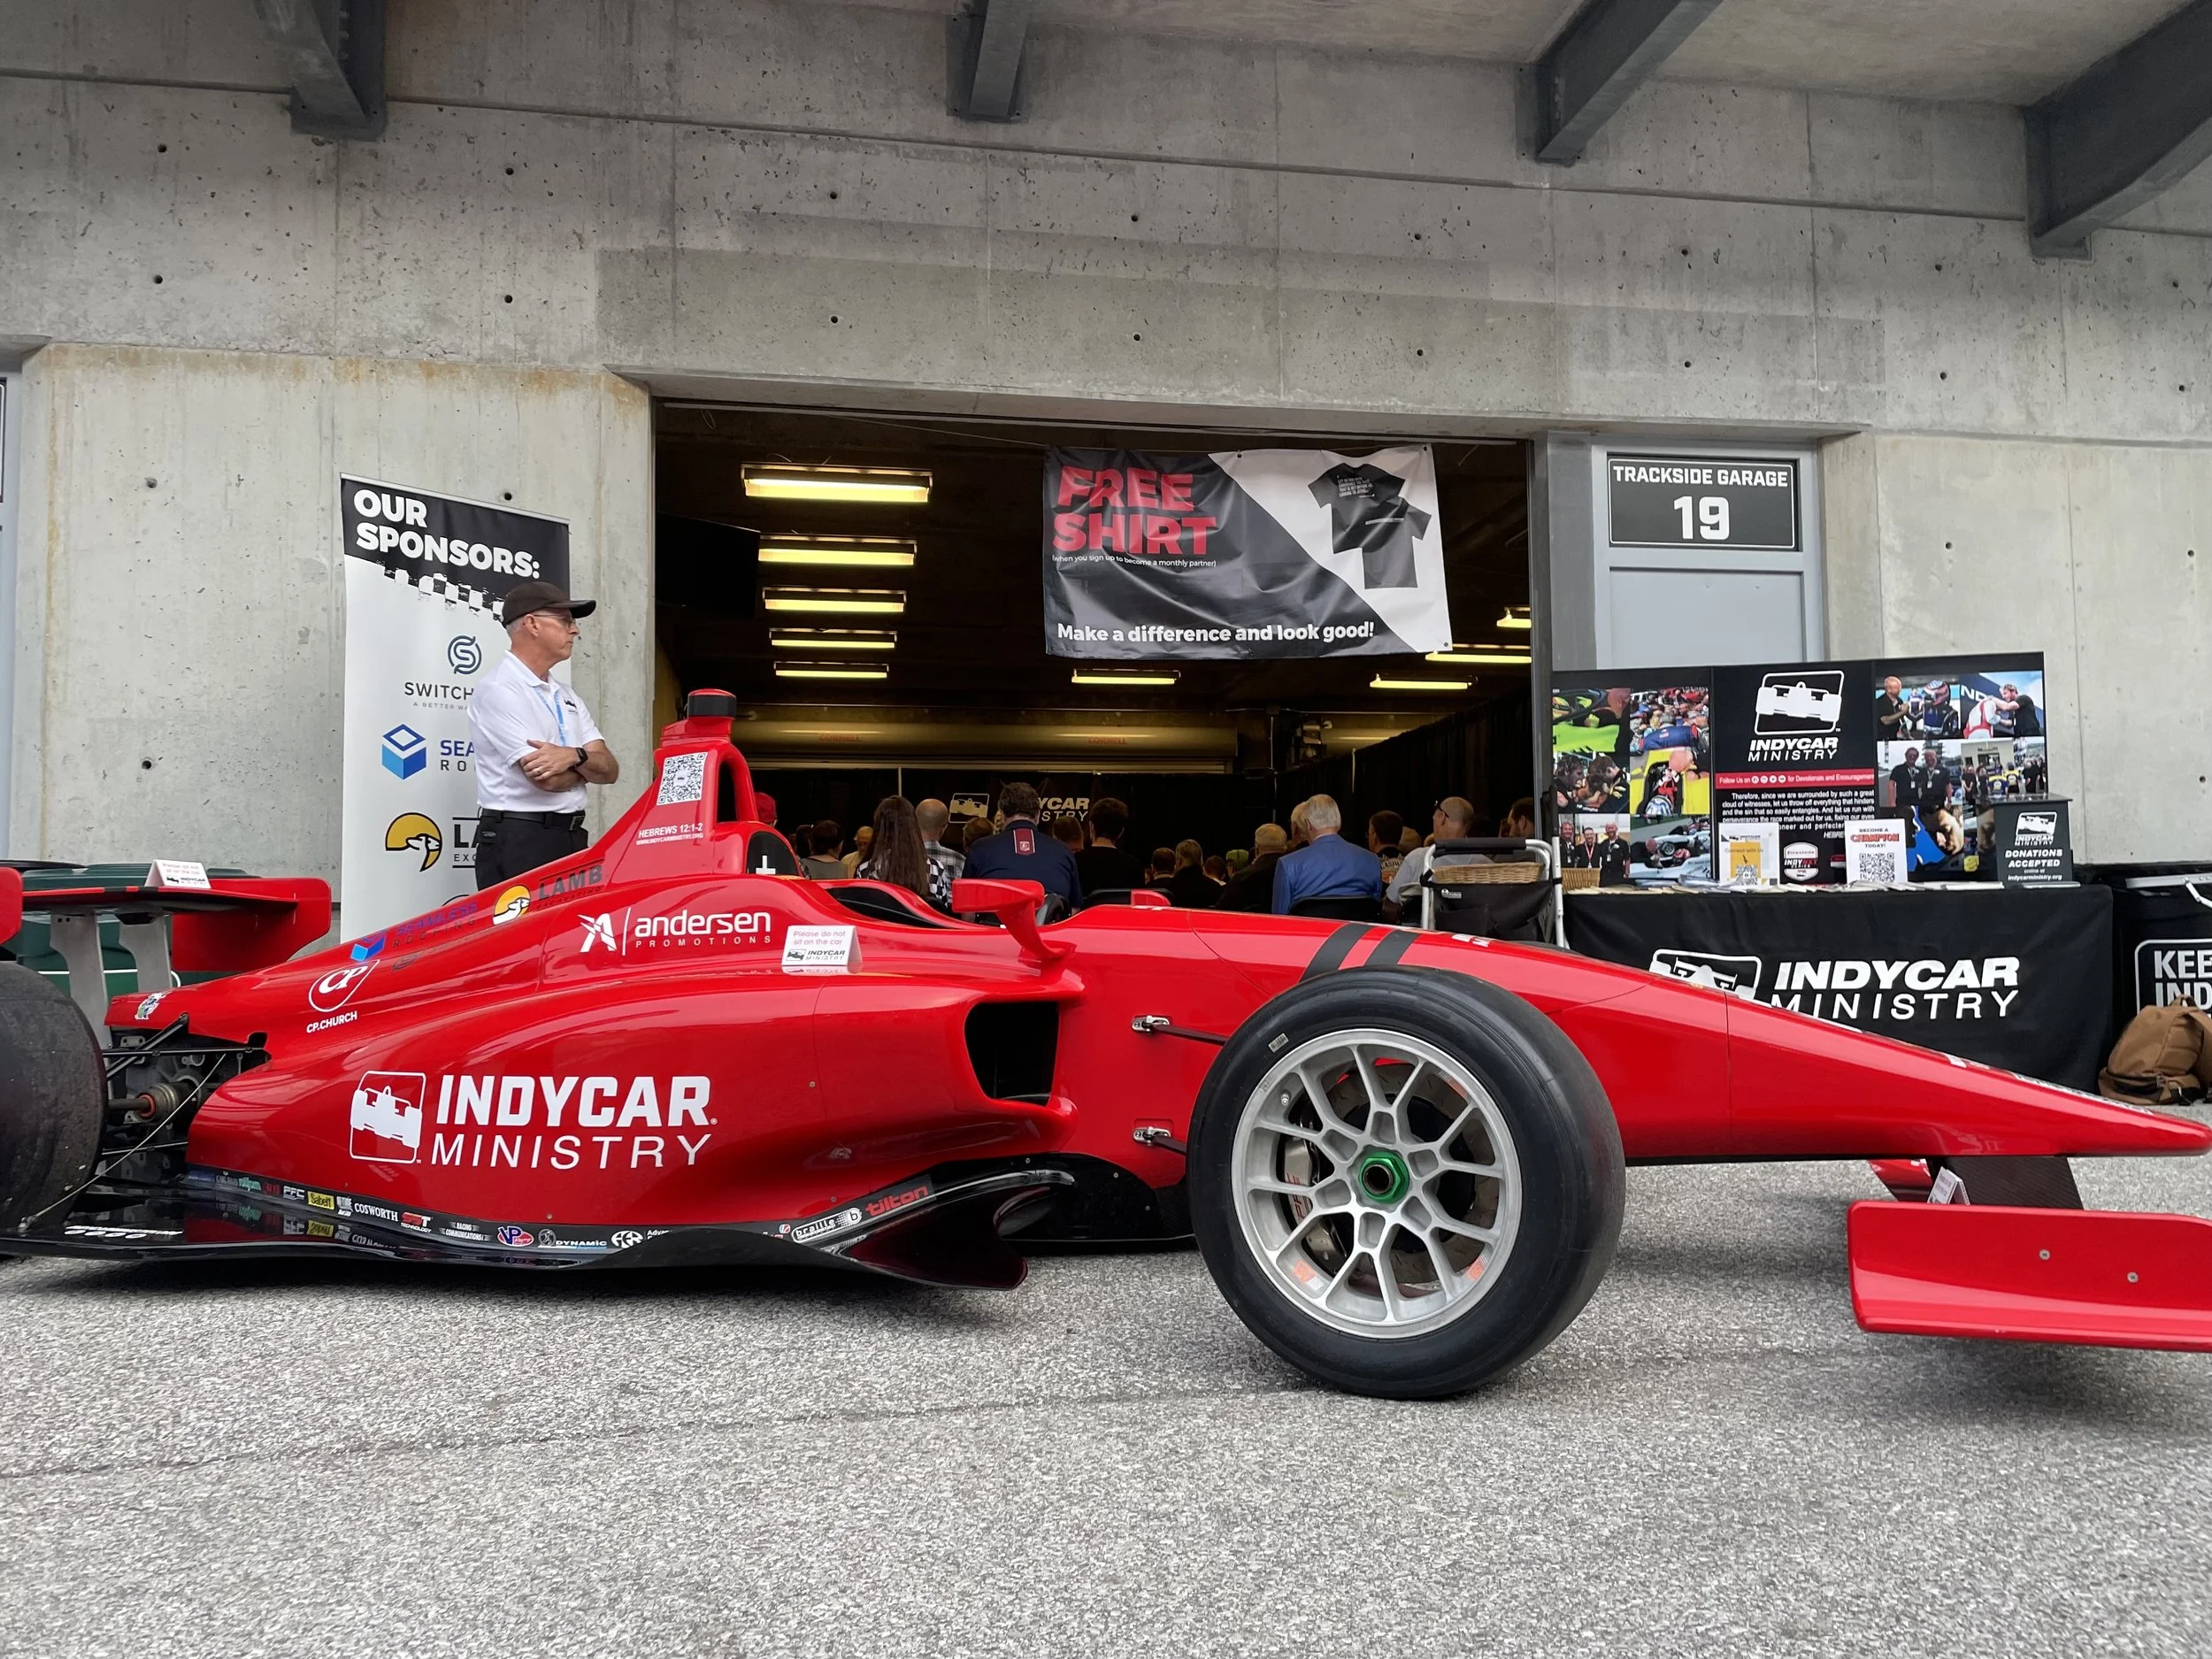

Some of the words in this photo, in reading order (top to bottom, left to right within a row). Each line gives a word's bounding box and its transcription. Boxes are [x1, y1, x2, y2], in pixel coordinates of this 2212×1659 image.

[1613, 465, 1713, 485] TRACKSIDE
[1717, 469, 1788, 487] GARAGE
[1057, 465, 1194, 511] FREE
[354, 488, 428, 529] OUR
[1674, 495, 1730, 540] 19
[1052, 511, 1217, 556] SHIRT
[356, 522, 541, 580] SPONSORS:
[1074, 555, 1087, 564] you
[1089, 554, 1104, 563] sign
[1125, 557, 1152, 566] become
[1158, 558, 1188, 568] monthly
[1057, 623, 1109, 641] Make
[1112, 630, 1125, 641] a
[1127, 624, 1232, 642] difference
[1234, 624, 1273, 641] and
[1277, 623, 1320, 641] look
[1323, 620, 1374, 643] good!
[1749, 736, 1839, 751] INDYCAR
[1747, 749, 1838, 762] MINISTRY
[1788, 798, 1804, 807] throw
[1813, 798, 1842, 807] everything
[1842, 797, 1853, 806] that
[1854, 796, 1875, 805] hinders
[1797, 790, 1830, 799] surrounded
[1830, 790, 1839, 799] by
[1859, 789, 1875, 798] great
[1774, 806, 1791, 816] easily
[1792, 806, 1820, 816] entangles.
[1862, 804, 1875, 813] with
[1783, 814, 1804, 823] marked
[1834, 812, 1849, 822] fixing
[638, 825, 678, 839] HEBREWS
[680, 822, 703, 833] 12:1-2
[1850, 833, 1900, 842] CHAMPION
[2005, 849, 2063, 858] DONATIONS
[2008, 859, 2061, 868] ACCEPTED
[538, 864, 603, 902] LAMB
[396, 902, 478, 935] SEAMLESS
[634, 910, 772, 938] andersen
[635, 935, 772, 949] PROMOTIONS
[1774, 956, 2020, 991] INDYCAR
[1770, 989, 2019, 1021] MINISTRY
[306, 1010, 358, 1033] CP.CHURCH
[435, 1074, 711, 1128] INDYCAR
[430, 1132, 713, 1170] MINISTRY
[354, 1202, 399, 1223] COSWORTH
[865, 1186, 929, 1217] tilton
[498, 1225, 523, 1246] VP
[795, 1217, 835, 1237] braille
